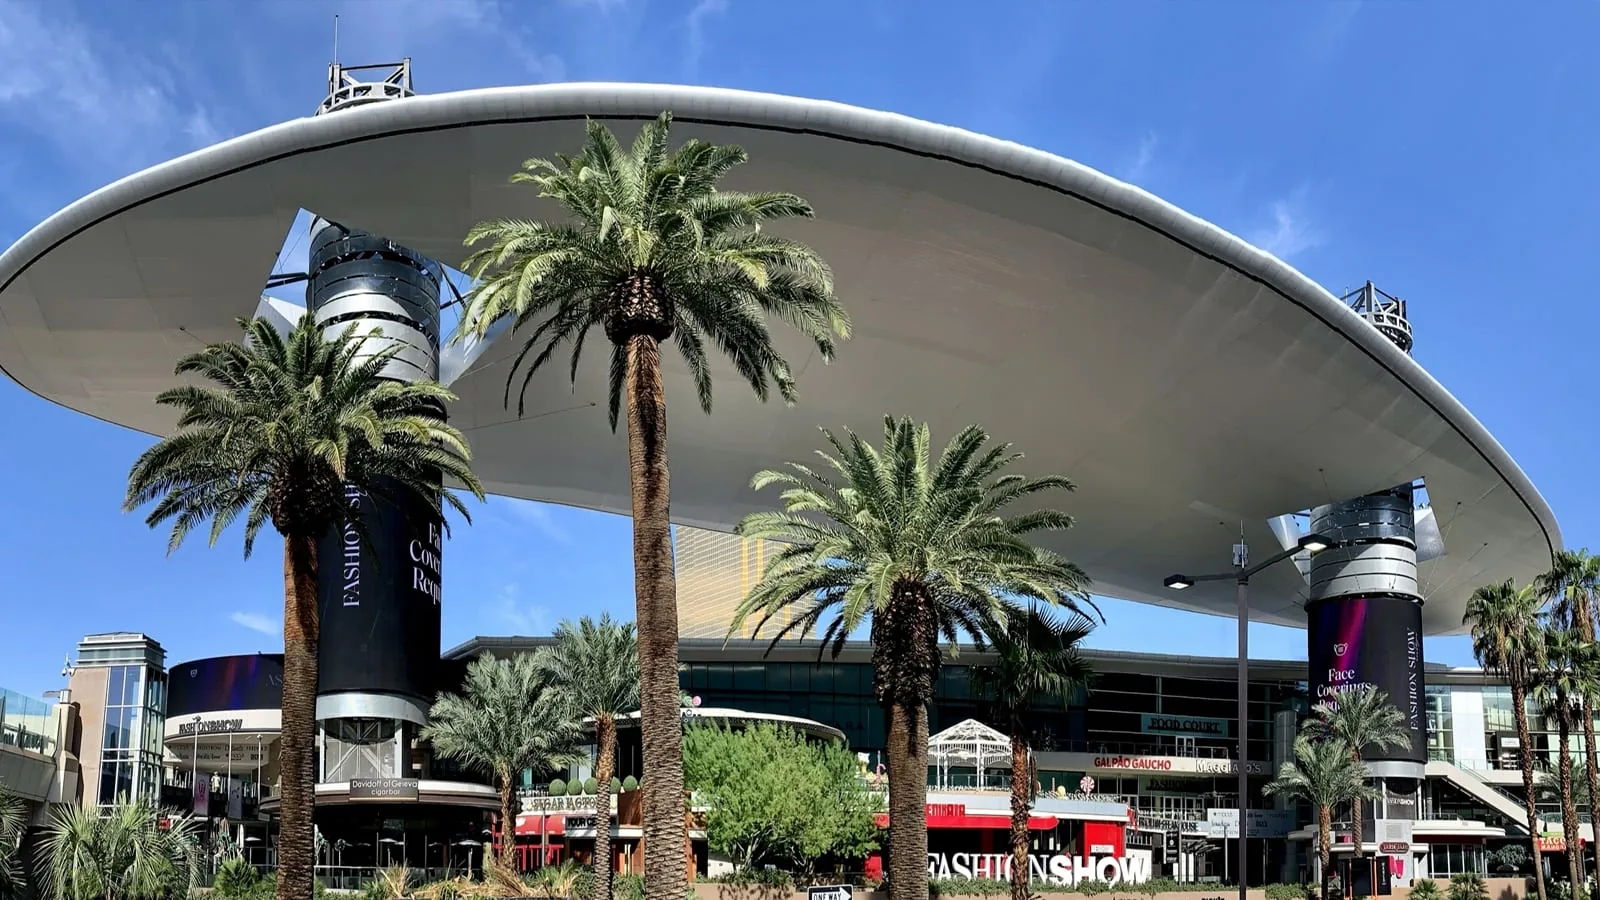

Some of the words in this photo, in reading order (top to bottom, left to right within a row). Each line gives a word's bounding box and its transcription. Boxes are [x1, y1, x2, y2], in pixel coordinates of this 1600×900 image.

[1406, 627, 1417, 669] SHOW
[1328, 668, 1356, 682] Face
[1408, 672, 1419, 731] FASHION
[179, 718, 243, 734] FASHONSHOW
[1150, 717, 1181, 729] FOOD
[1183, 719, 1220, 732] COURT
[1094, 755, 1131, 769] GALPÃO
[1132, 758, 1171, 770] GAUCHO
[1196, 759, 1262, 774] MAGGIAO'S
[352, 780, 381, 788] Davidoff
[383, 780, 391, 788] of
[391, 780, 418, 788] Geneva
[566, 796, 598, 811] FACTO
[567, 817, 586, 827] TOUR
